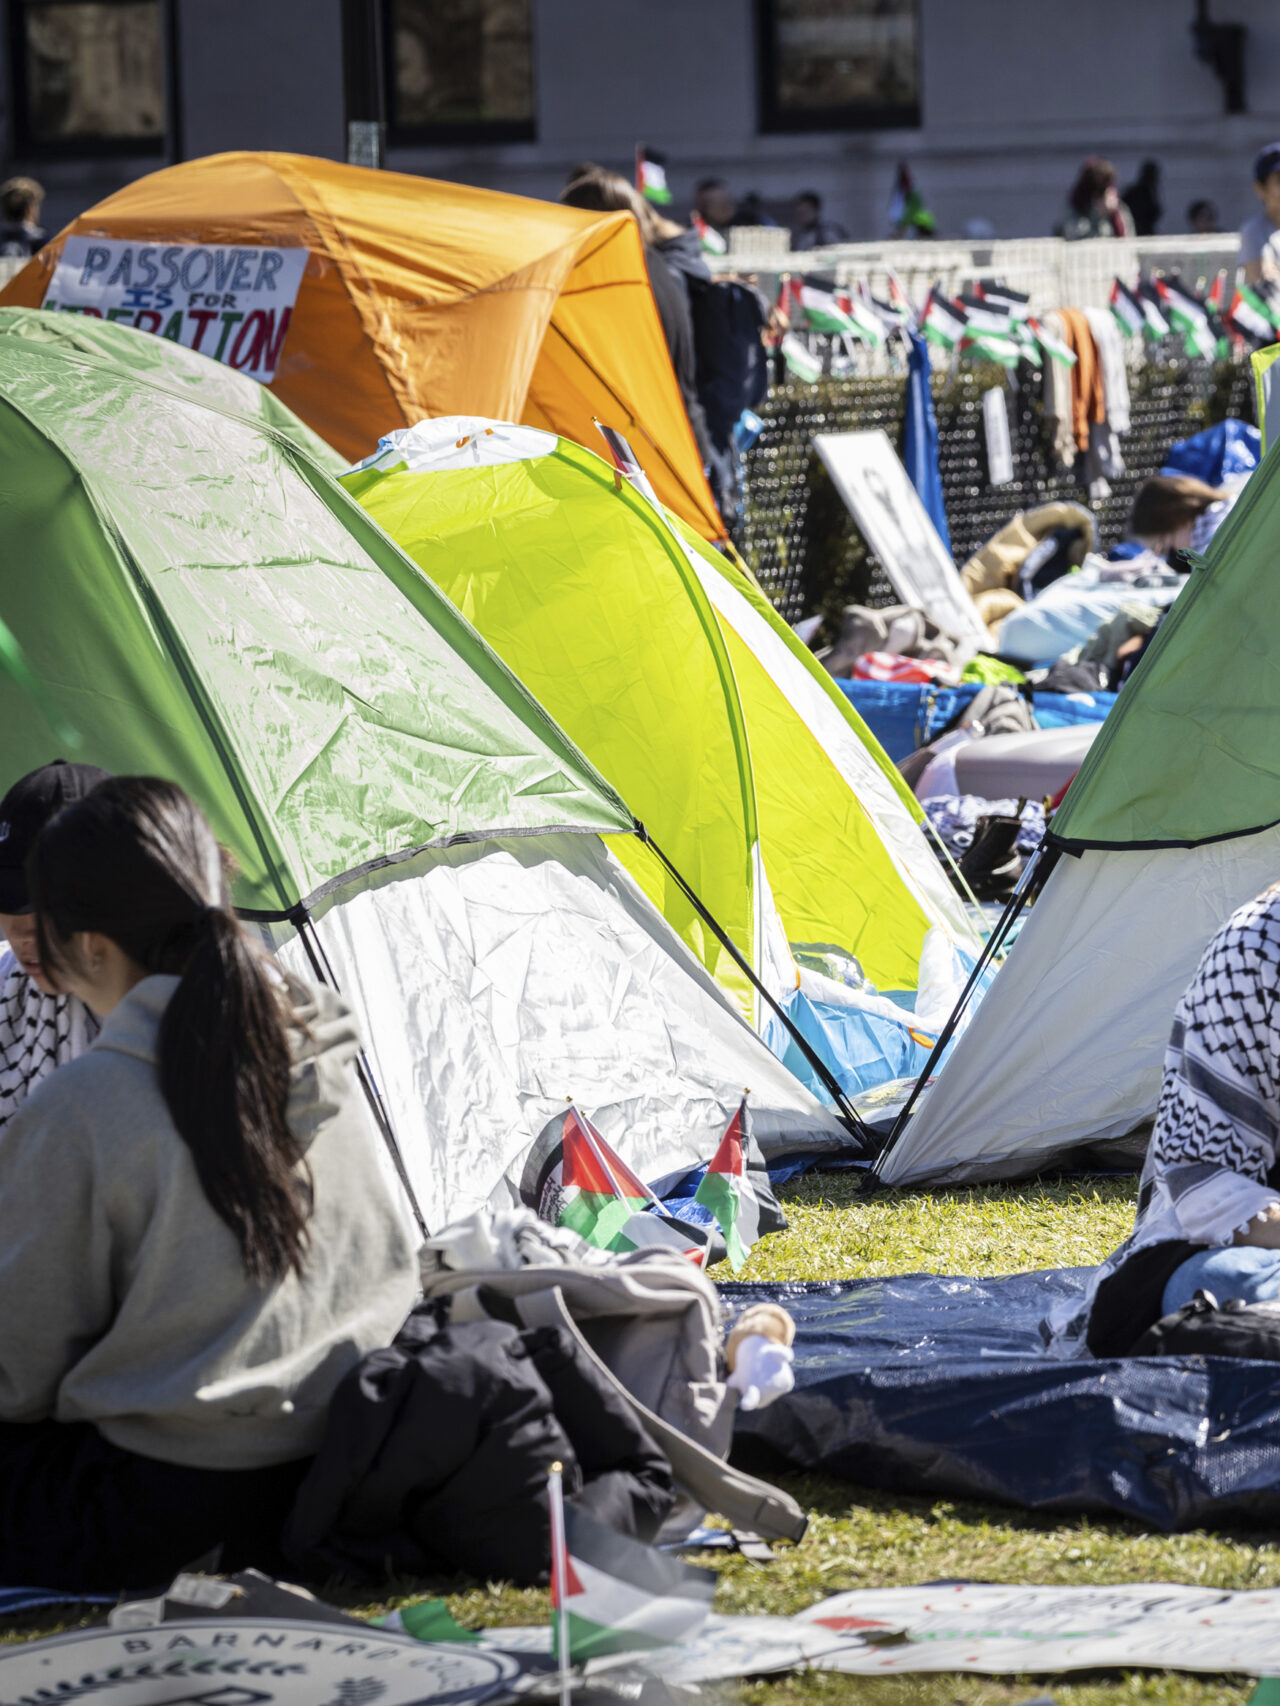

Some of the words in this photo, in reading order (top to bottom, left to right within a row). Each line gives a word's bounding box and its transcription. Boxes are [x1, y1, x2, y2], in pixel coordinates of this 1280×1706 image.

[79, 247, 284, 291] PASSOVER
[121, 288, 174, 309] IS
[187, 292, 237, 309] FOR
[44, 300, 293, 372] ATION
